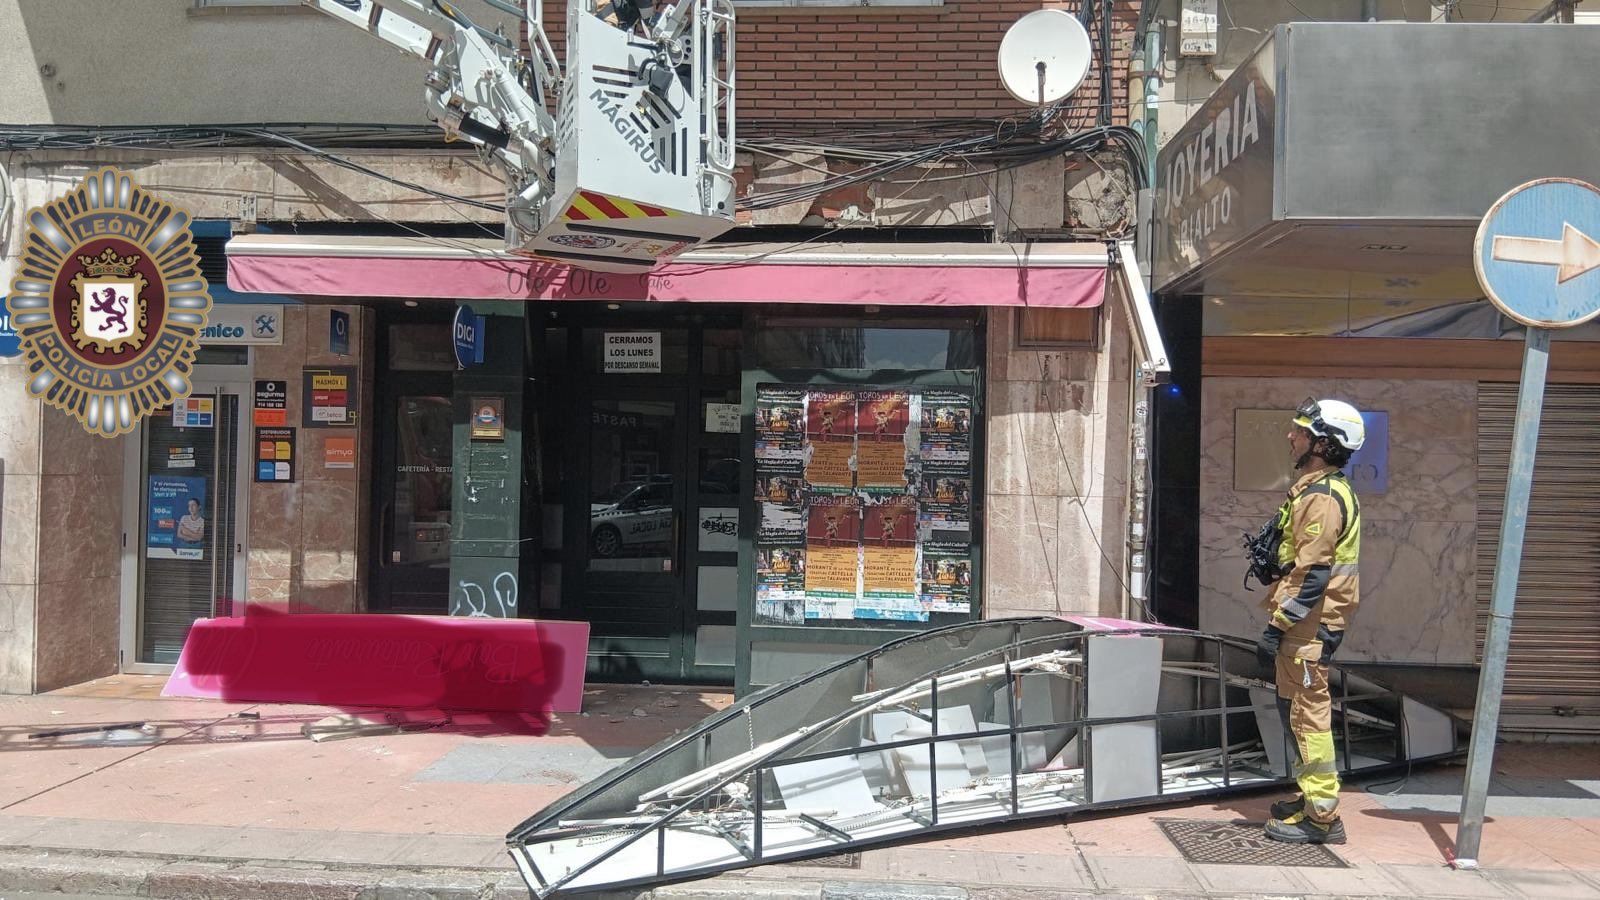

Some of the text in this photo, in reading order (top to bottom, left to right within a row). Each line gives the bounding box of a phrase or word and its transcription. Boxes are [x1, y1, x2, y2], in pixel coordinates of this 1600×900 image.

[589, 88, 661, 174] MAGIRUS
[1164, 79, 1259, 219] JOYERIA
[1179, 186, 1231, 251] RIALTO
[457, 322, 475, 344] DIGI
[608, 336, 654, 344] CERRAMOS
[610, 349, 654, 357] LOS LUNES
